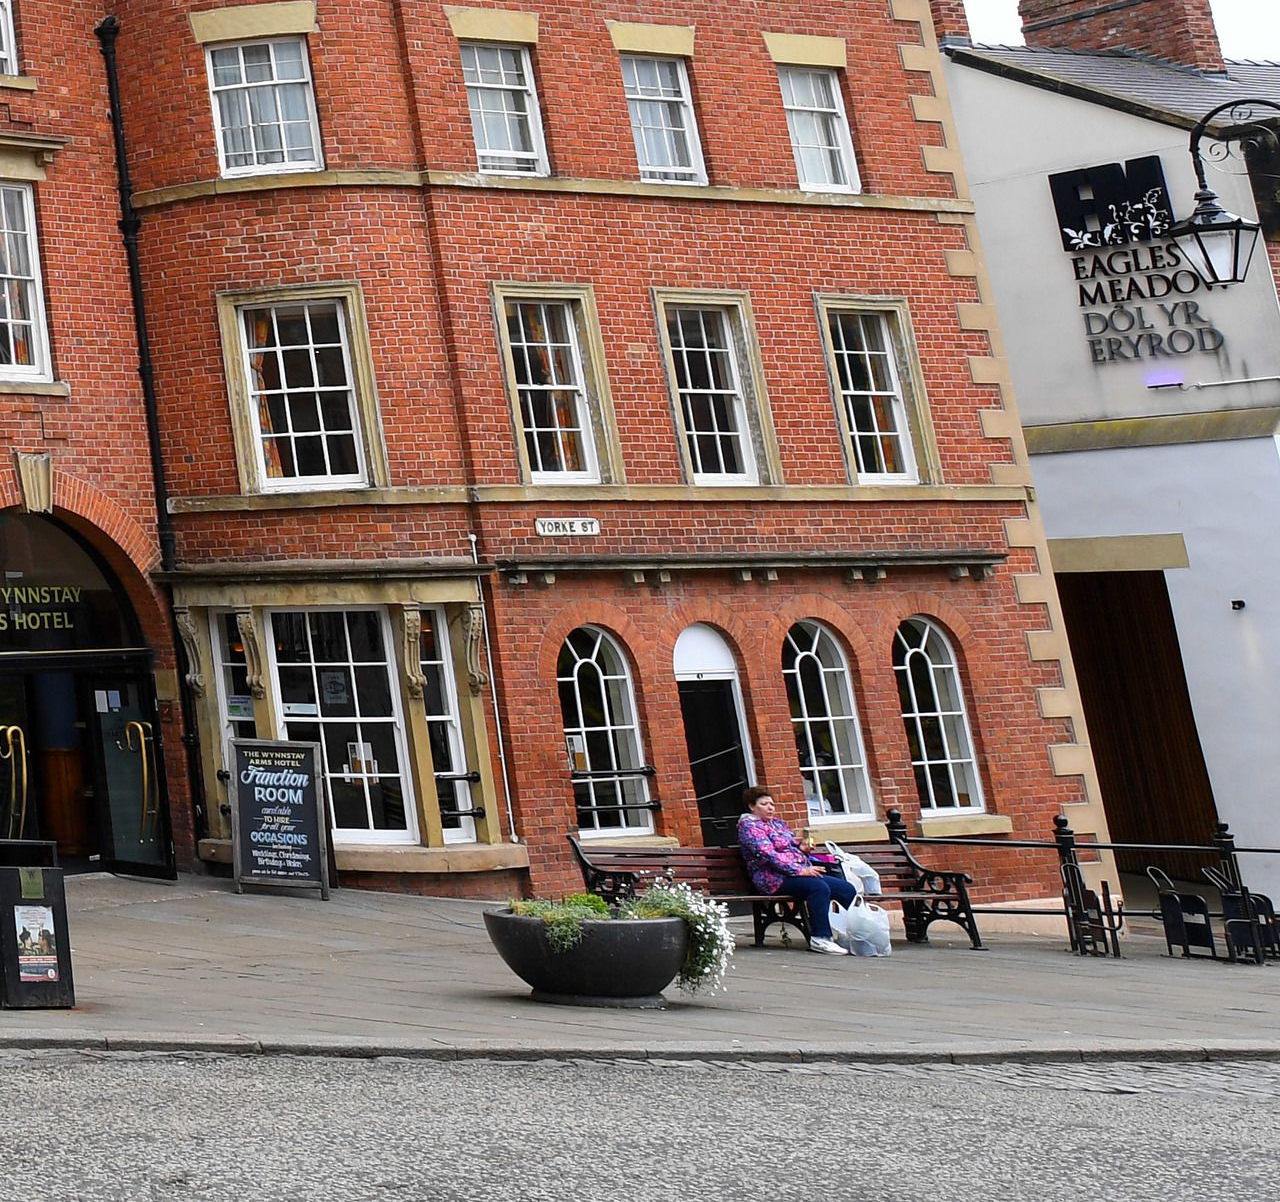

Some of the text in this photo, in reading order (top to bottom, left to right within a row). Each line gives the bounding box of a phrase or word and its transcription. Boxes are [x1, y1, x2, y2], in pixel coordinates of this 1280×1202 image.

[1071, 243, 1181, 280] EAGLES
[1078, 269, 1227, 306] MEADO
[1083, 301, 1209, 336] DÔL YR
[1087, 327, 1224, 363] ERYROD
[540, 521, 595, 533] YORKE ST
[14, 612, 74, 630] HOTEL
[243, 750, 305, 760] THE WYNNSTAY
[249, 758, 273, 766] ARMS
[240, 765, 309, 788] Function
[254, 786, 304, 805] ROOM
[264, 815, 273, 823] TO
[250, 831, 308, 845] OCCASIONS
